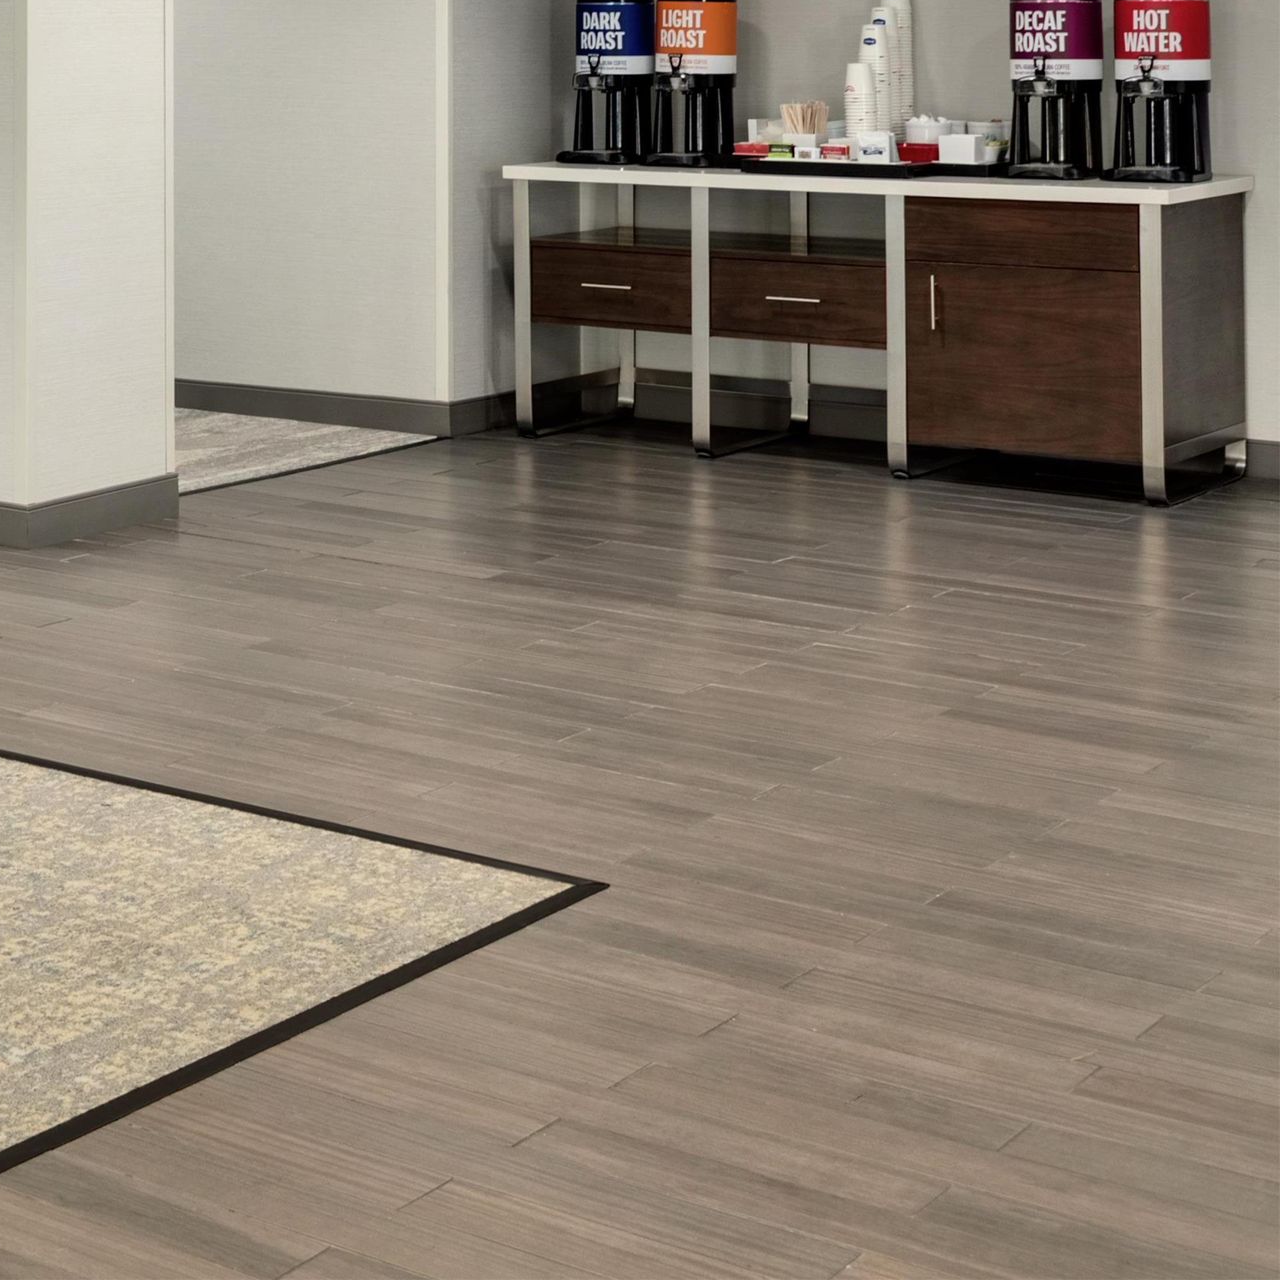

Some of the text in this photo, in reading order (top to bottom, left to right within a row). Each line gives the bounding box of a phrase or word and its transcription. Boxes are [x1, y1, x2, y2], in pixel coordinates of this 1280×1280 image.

[582, 12, 622, 31] DARK
[662, 9, 704, 29] LIGHT
[1015, 10, 1067, 31] DECAF
[1132, 9, 1170, 31] HOT
[580, 31, 626, 50] ROAST
[660, 29, 707, 49] ROAST
[1015, 32, 1069, 53] ROAST
[1123, 31, 1183, 53] WATER
